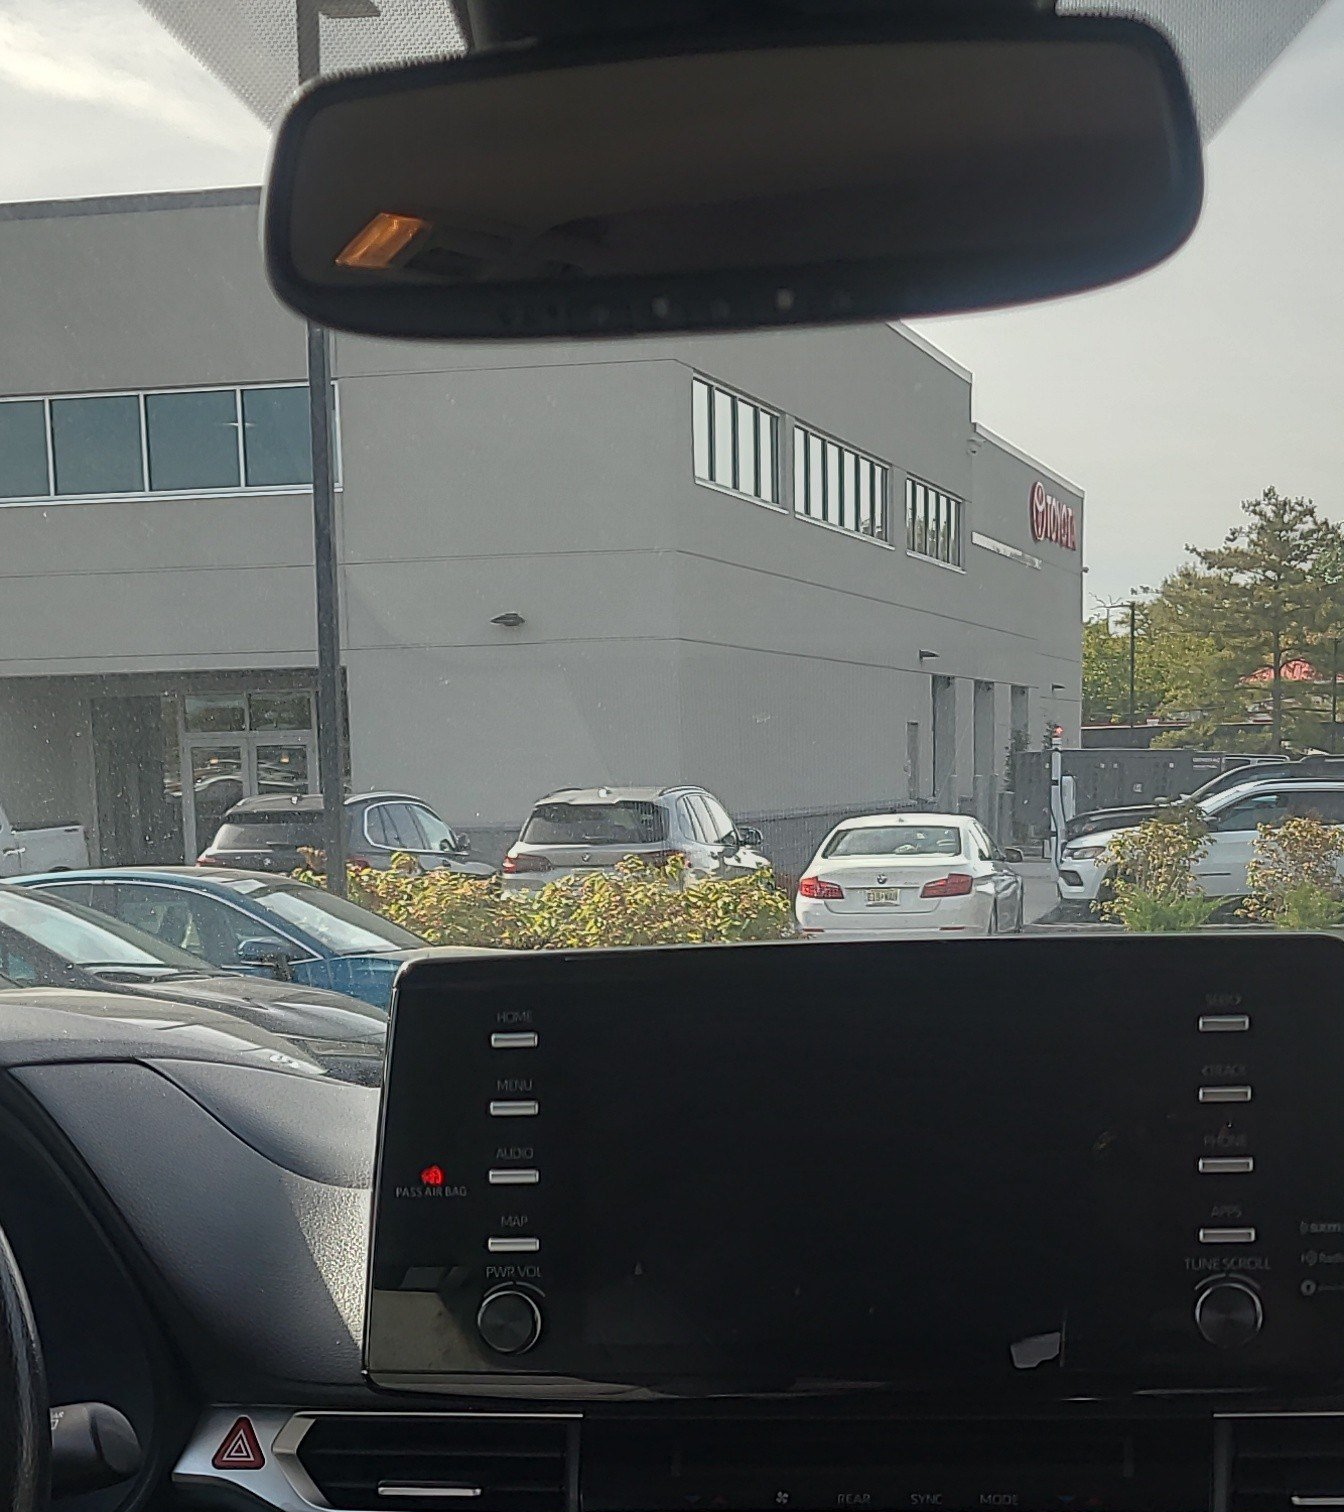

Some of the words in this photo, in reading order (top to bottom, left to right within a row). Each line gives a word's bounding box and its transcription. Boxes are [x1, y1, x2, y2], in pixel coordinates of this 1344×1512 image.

[497, 1080, 533, 1091] MENU
[496, 1148, 534, 1159] AUDIO
[396, 1187, 422, 1197] PASS
[425, 1187, 443, 1197] AIR
[445, 1186, 467, 1197] BAG
[501, 1216, 528, 1227] MAP
[1185, 1257, 1218, 1270] TUNE
[1223, 1257, 1271, 1270] SCROLL
[486, 1266, 515, 1278] PWR
[519, 1265, 542, 1278] VOL
[837, 1493, 871, 1505] REAR
[910, 1493, 942, 1505] SYNC
[980, 1493, 1018, 1505] MODE
